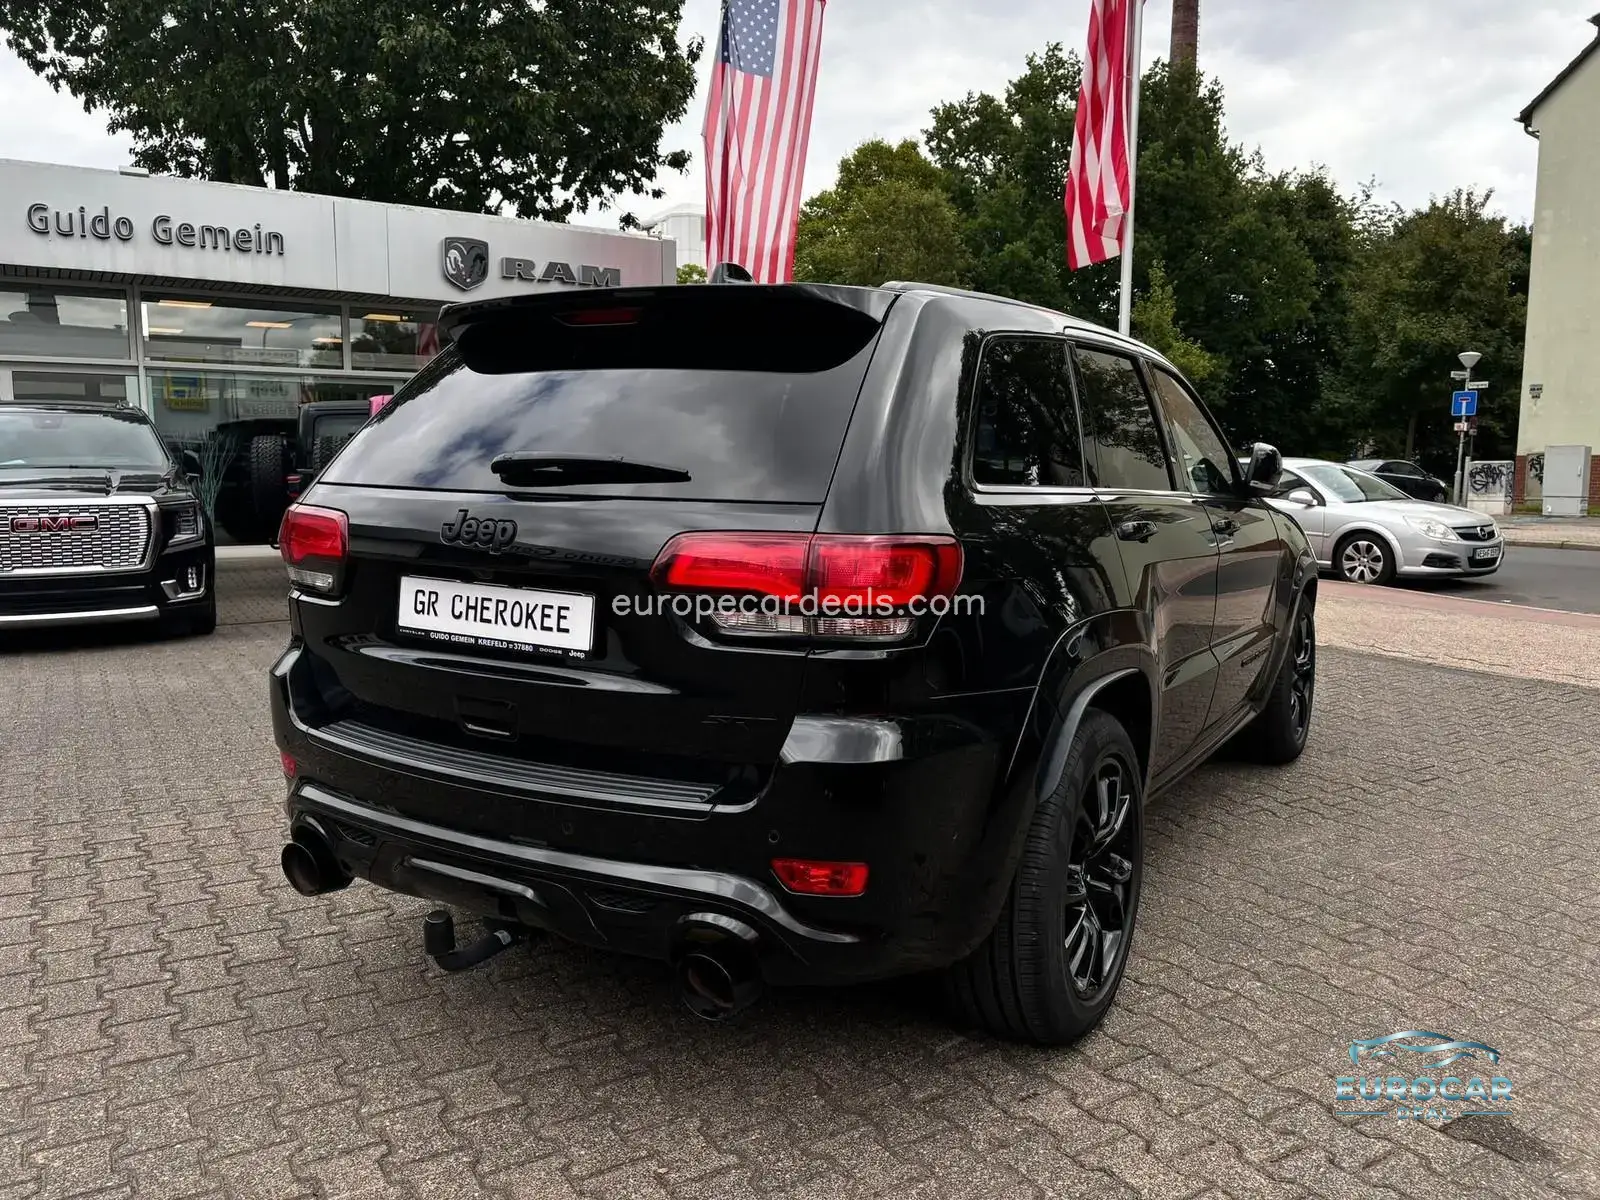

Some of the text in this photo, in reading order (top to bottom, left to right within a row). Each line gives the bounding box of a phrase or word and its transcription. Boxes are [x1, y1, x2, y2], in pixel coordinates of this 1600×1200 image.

[27, 202, 286, 255] Guido Gemein
[500, 257, 621, 287] RAM
[13, 517, 96, 533] GMC
[440, 509, 518, 555] Jeep
[413, 589, 571, 634] GR CHEROKEE
[430, 632, 449, 641] GUIDO
[450, 635, 475, 645] GEMEIN
[478, 638, 508, 649] KREFELD
[568, 650, 586, 660] Jeep
